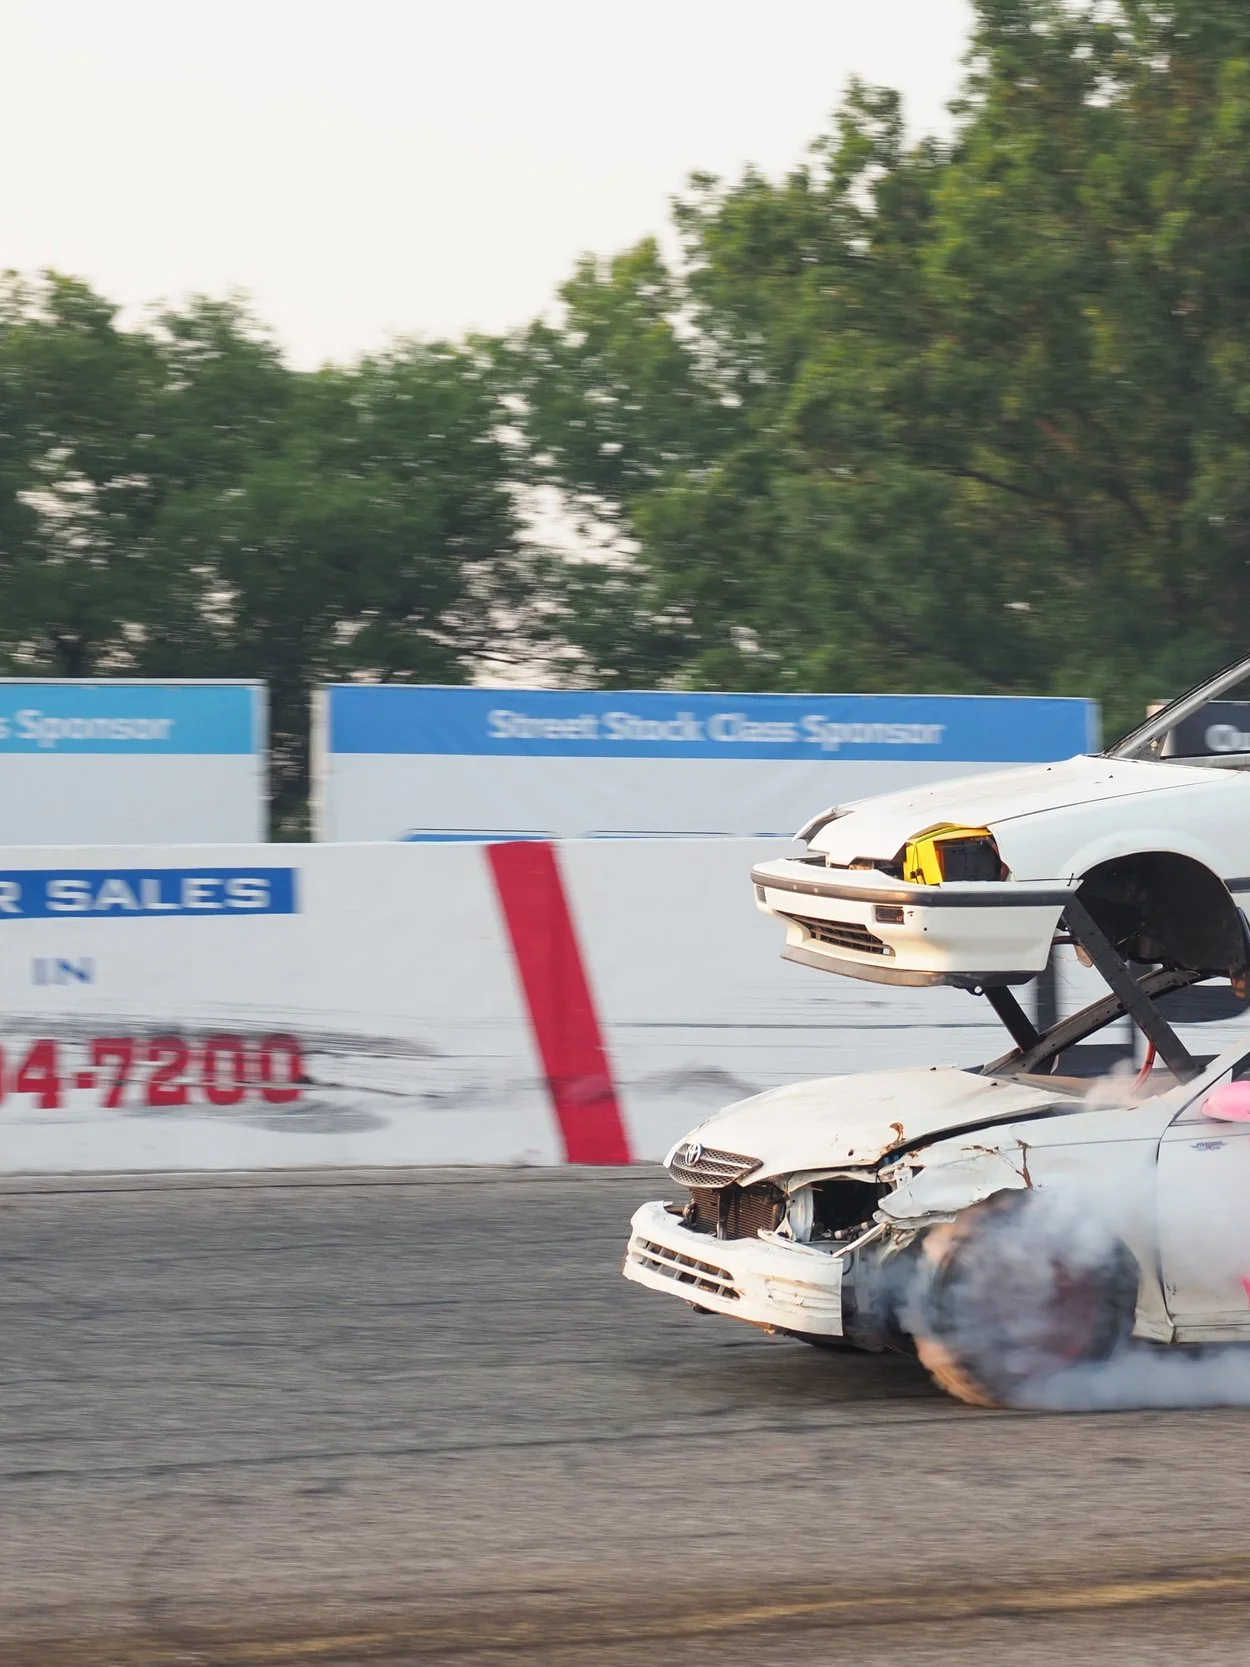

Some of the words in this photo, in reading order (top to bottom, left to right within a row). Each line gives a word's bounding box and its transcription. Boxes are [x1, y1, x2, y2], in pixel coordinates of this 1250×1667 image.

[14, 709, 176, 748] Sponsor
[487, 710, 599, 740] Street
[601, 712, 705, 742] Stock
[708, 712, 798, 743] Class
[801, 714, 946, 751] Sponsor
[46, 877, 272, 912] SALES
[32, 956, 96, 986] IN
[0, 1033, 305, 1109] 4-7200
